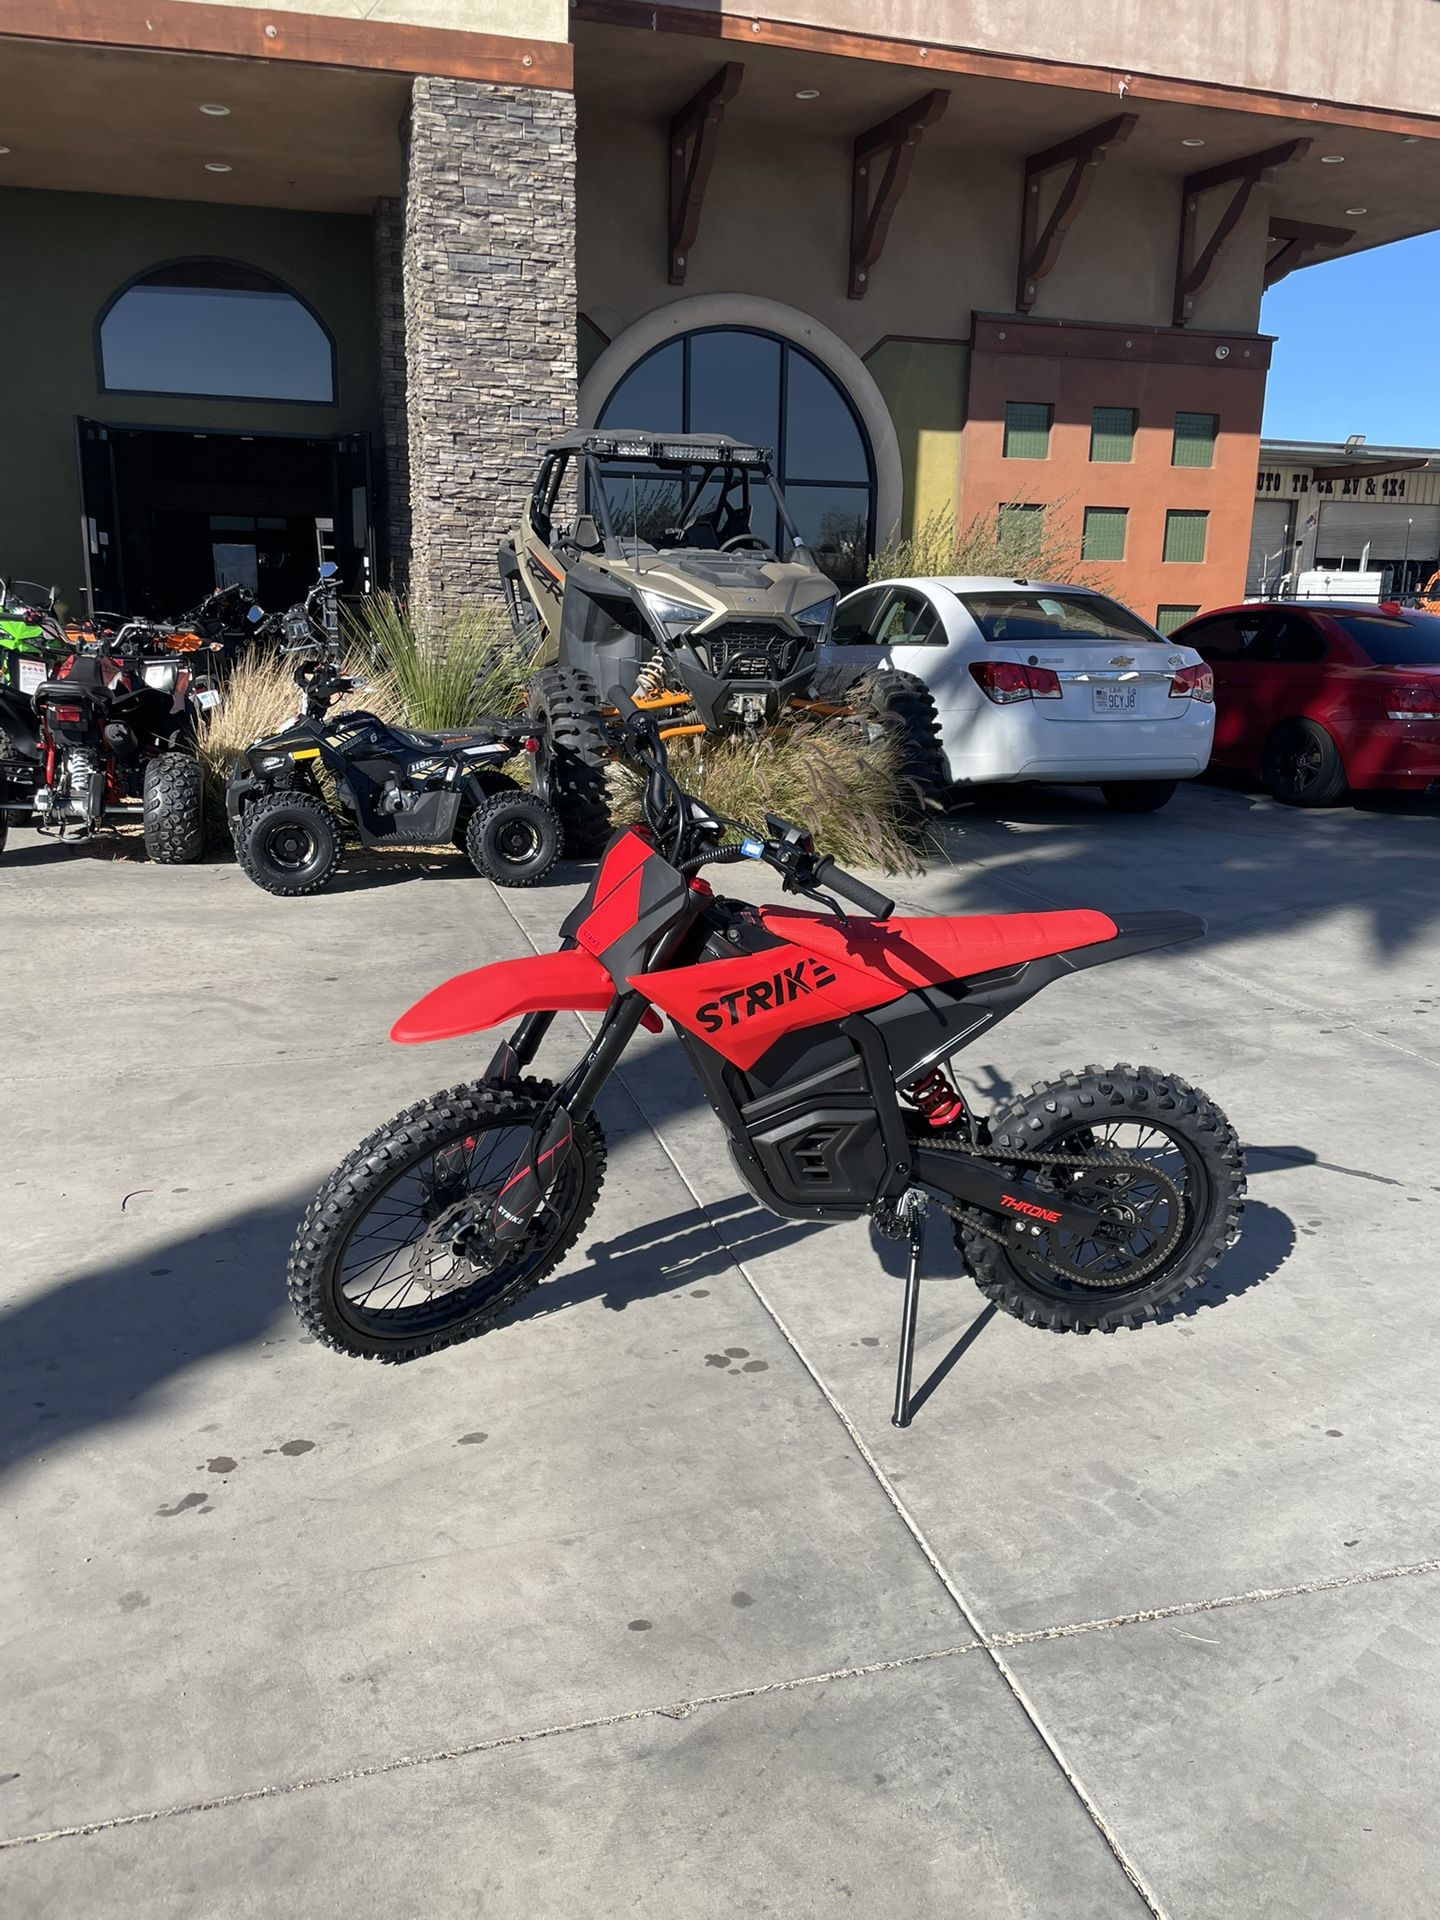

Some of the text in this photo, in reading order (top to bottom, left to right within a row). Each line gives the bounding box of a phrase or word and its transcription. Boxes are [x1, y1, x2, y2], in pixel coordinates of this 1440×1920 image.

[1257, 473, 1281, 491] UTO
[1292, 474, 1333, 494] TRCK
[1365, 478, 1376, 495] &
[1382, 479, 1406, 497] 4X4
[696, 957, 837, 1034] STRIKE
[498, 1205, 525, 1225] STRIKE
[1000, 1194, 1063, 1223] THRONE
